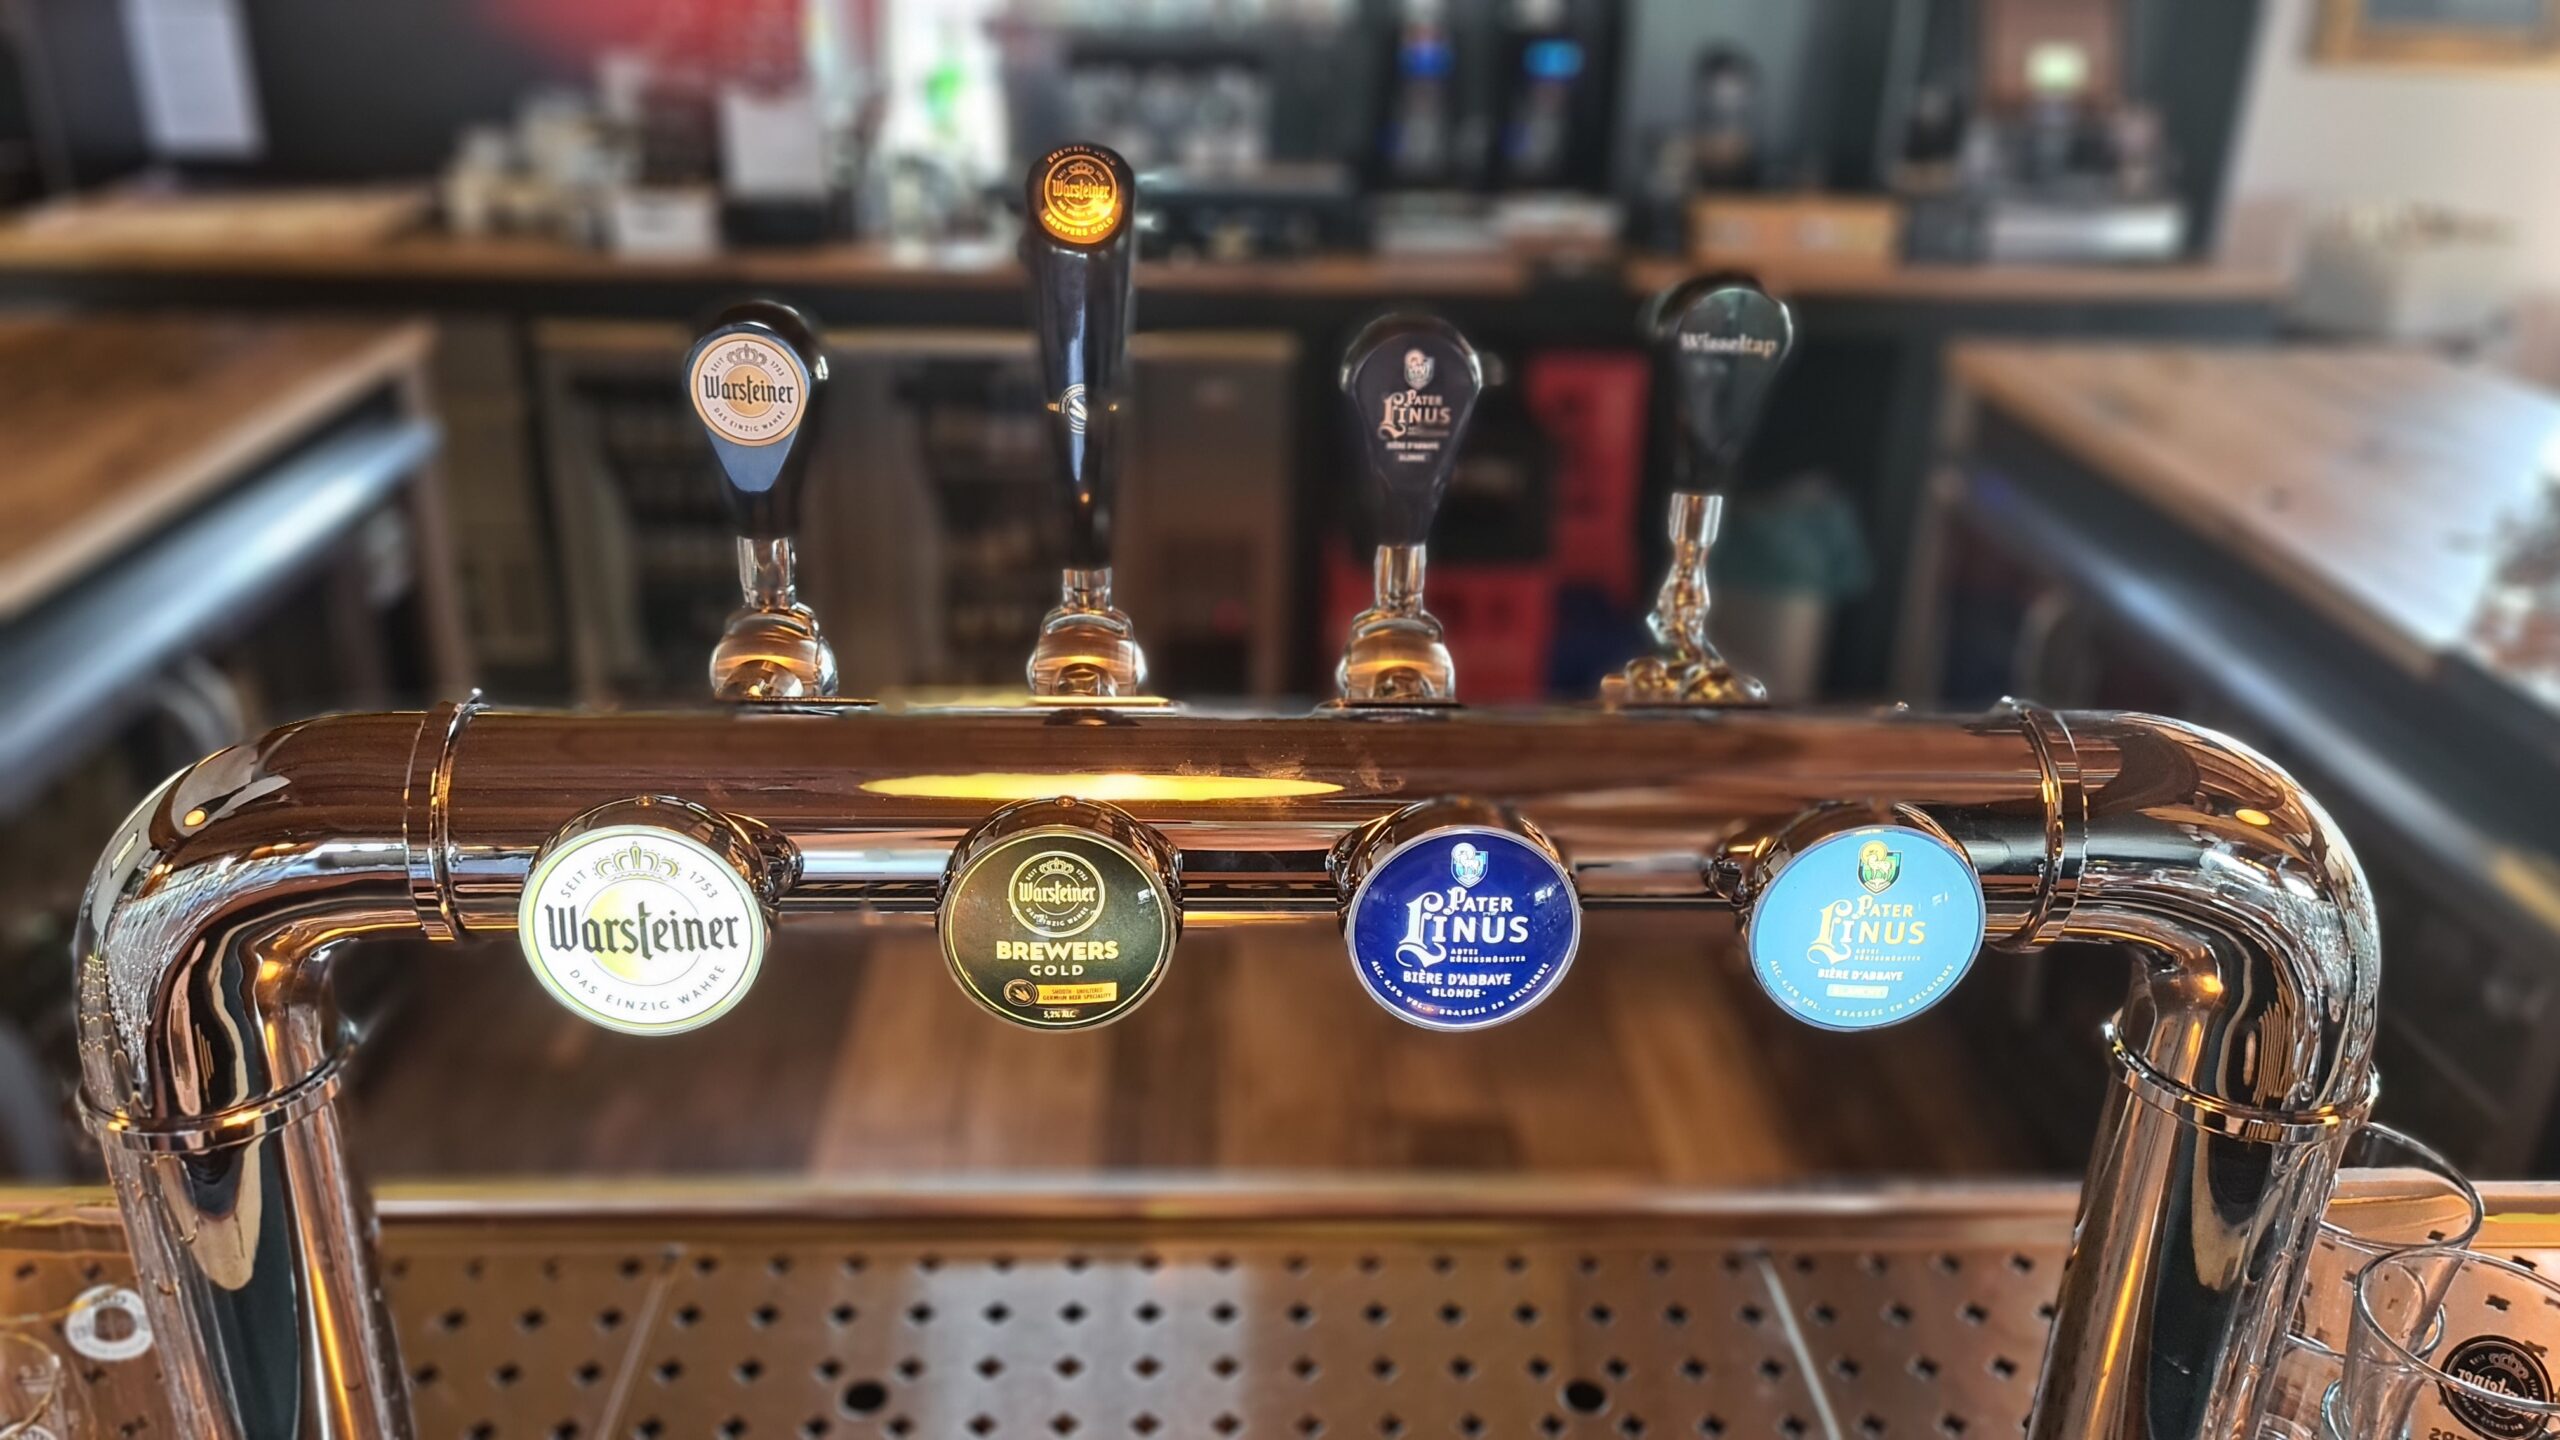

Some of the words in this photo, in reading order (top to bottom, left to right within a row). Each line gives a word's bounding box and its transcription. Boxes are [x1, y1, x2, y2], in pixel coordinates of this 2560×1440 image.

[1044, 213, 1089, 236] BREWERS
[1091, 217, 1114, 234] GOLD
[703, 374, 794, 405] Warsteiner
[714, 407, 727, 421] DAS
[730, 421, 759, 432] EINZIG
[761, 411, 785, 429] WAHRE
[1378, 392, 1452, 439] LINUS
[560, 870, 587, 898] SEIT
[689, 871, 718, 899] 1753
[1018, 880, 1096, 905] Warsteiner
[1443, 886, 1513, 915] PATER
[1852, 895, 1914, 920] PATER
[545, 900, 739, 960] Warsteiner
[1395, 891, 1529, 968] LINUS
[1807, 899, 1926, 965] LINUS
[996, 940, 1119, 961] BREWERS
[1029, 965, 1084, 977] GOLD
[1403, 968, 1443, 985] BIÈRE
[1448, 973, 1512, 986] D'ABBAYE
[1817, 966, 1849, 980] BIÈRE
[1851, 970, 1904, 981] D'ABBAYE
[569, 969, 597, 994] DAS
[605, 994, 670, 1011] EINZIG
[678, 965, 726, 1004] WAHRE
[1371, 961, 1384, 979] ALC.
[1491, 1000, 1505, 1010] EN
[1770, 960, 1782, 978] ALC.
[1802, 996, 1821, 1011] VOL.
[1889, 1002, 1903, 1012] EN
[1908, 964, 1954, 1005] BELGIQUE
